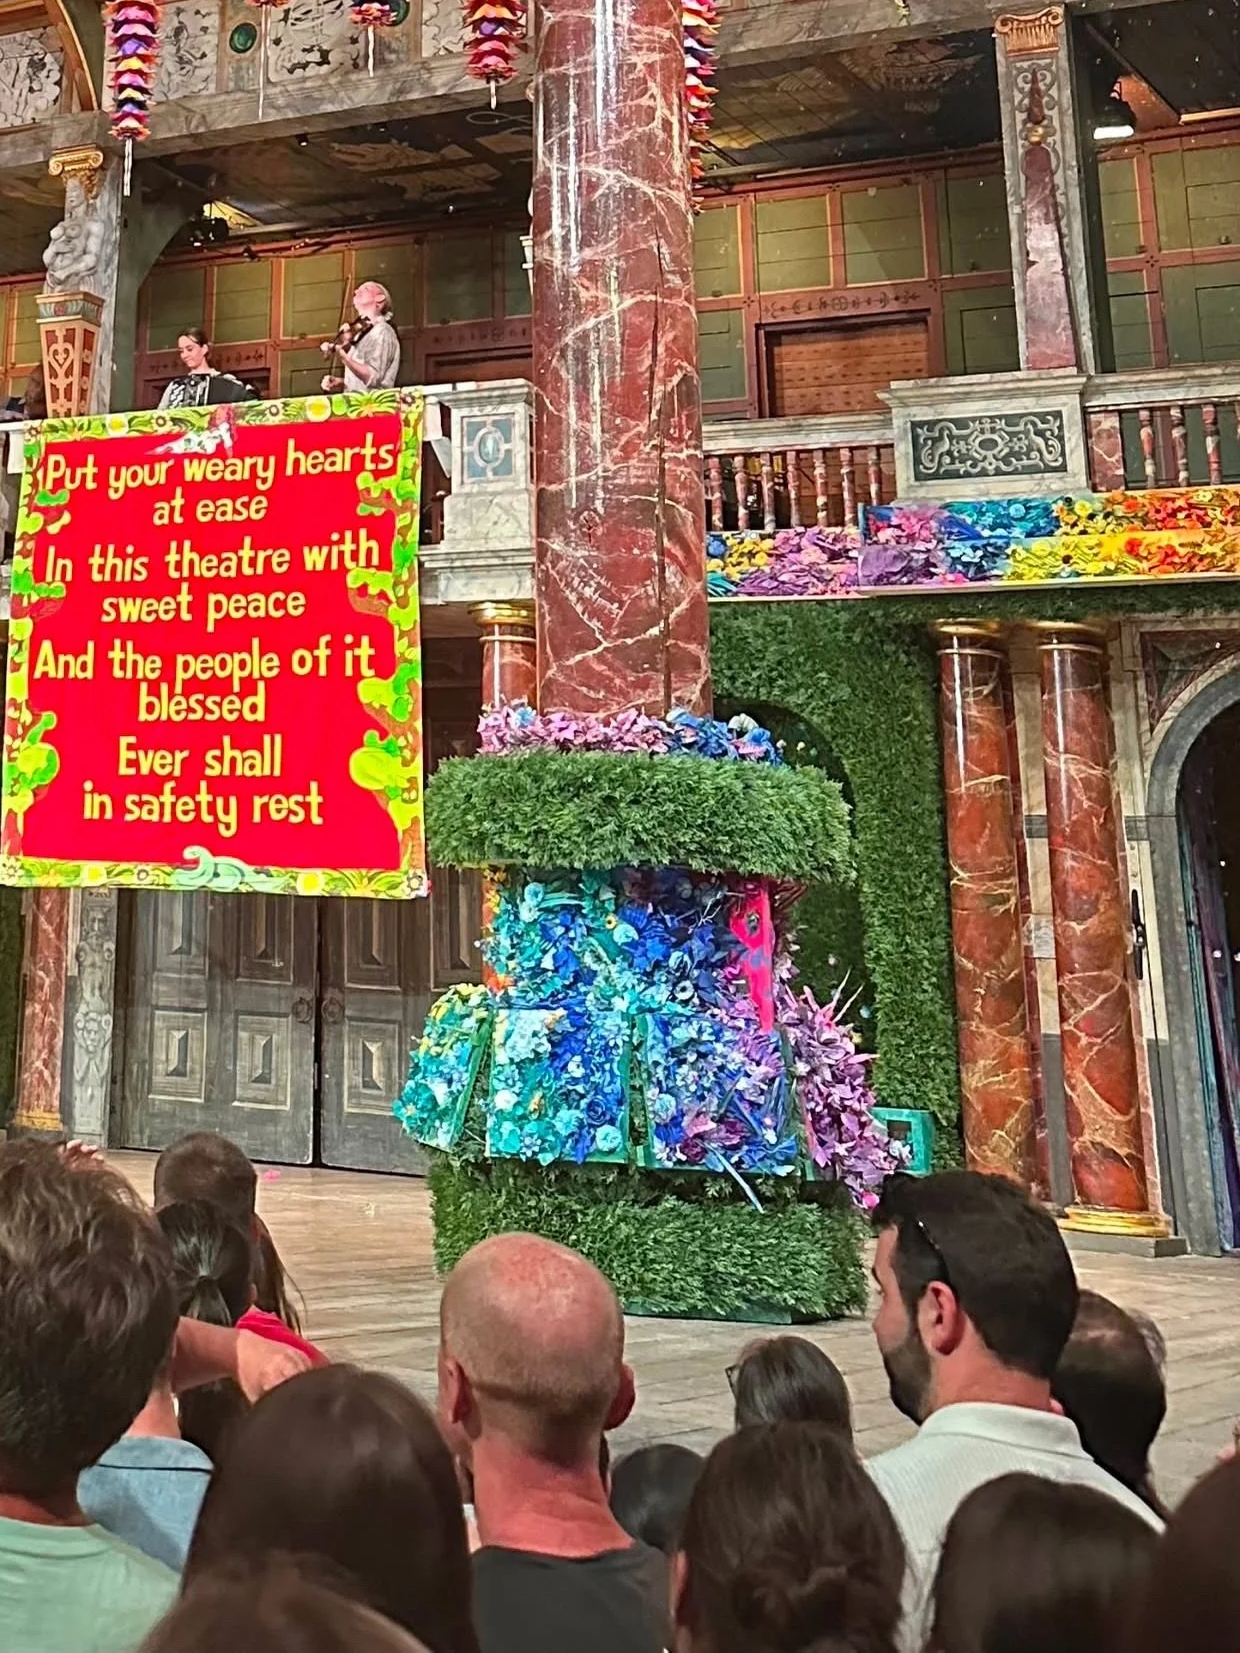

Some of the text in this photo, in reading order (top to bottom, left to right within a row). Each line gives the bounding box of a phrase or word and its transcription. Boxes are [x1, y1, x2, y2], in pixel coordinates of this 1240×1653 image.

[44, 432, 394, 499] Put your weary hearts
[153, 487, 267, 526] at ease
[45, 529, 379, 583] In this theatre with
[102, 583, 305, 631] sweet peace
[34, 635, 374, 694] And the people of it
[138, 682, 265, 722] blessed
[118, 734, 282, 777] Ever shall
[83, 781, 323, 838] in safety rest
